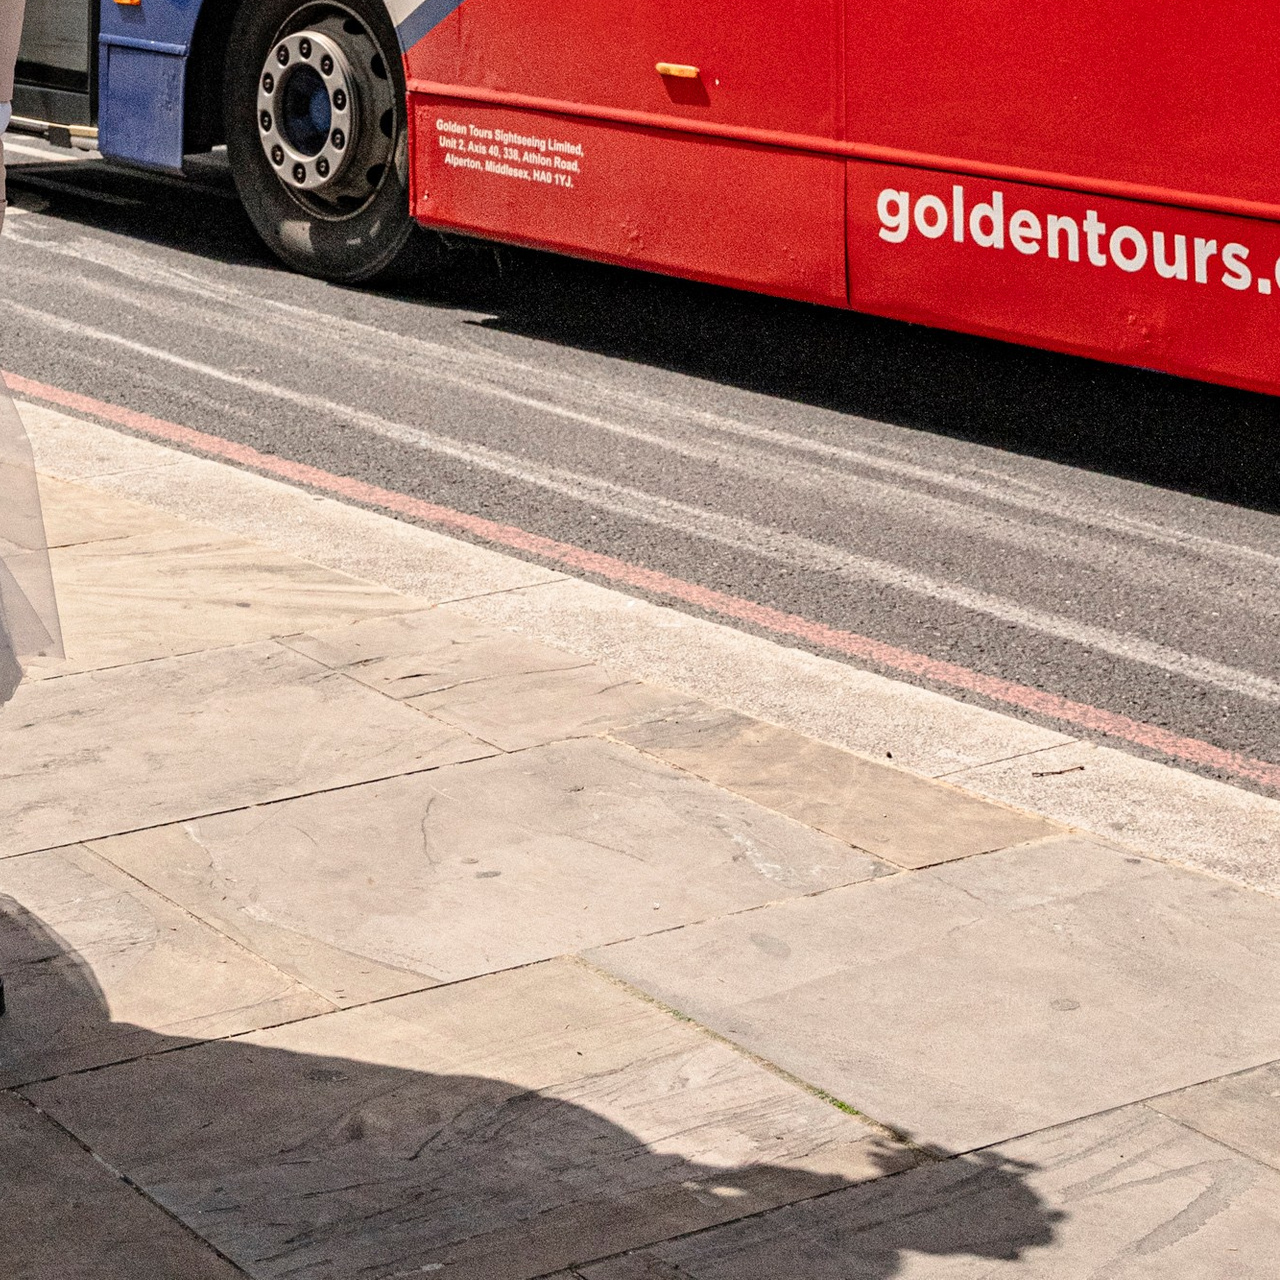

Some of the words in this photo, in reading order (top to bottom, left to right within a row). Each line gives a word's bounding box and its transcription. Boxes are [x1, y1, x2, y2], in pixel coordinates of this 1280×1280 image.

[436, 119, 467, 135] Golden
[468, 124, 493, 140] Tours
[494, 128, 547, 152] Sightseeing
[548, 138, 585, 158] Limited,
[439, 135, 457, 150] Unit
[458, 139, 466, 153] 2,
[467, 141, 487, 155] Axis
[488, 145, 501, 159] 40,
[503, 146, 521, 164] 338,
[522, 151, 552, 168] Athlon
[553, 155, 581, 175] Road,
[444, 152, 483, 172] Alperton,
[485, 160, 531, 182] Middlesex,
[533, 168, 553, 184] HA0
[876, 184, 1280, 295] goldentours.
